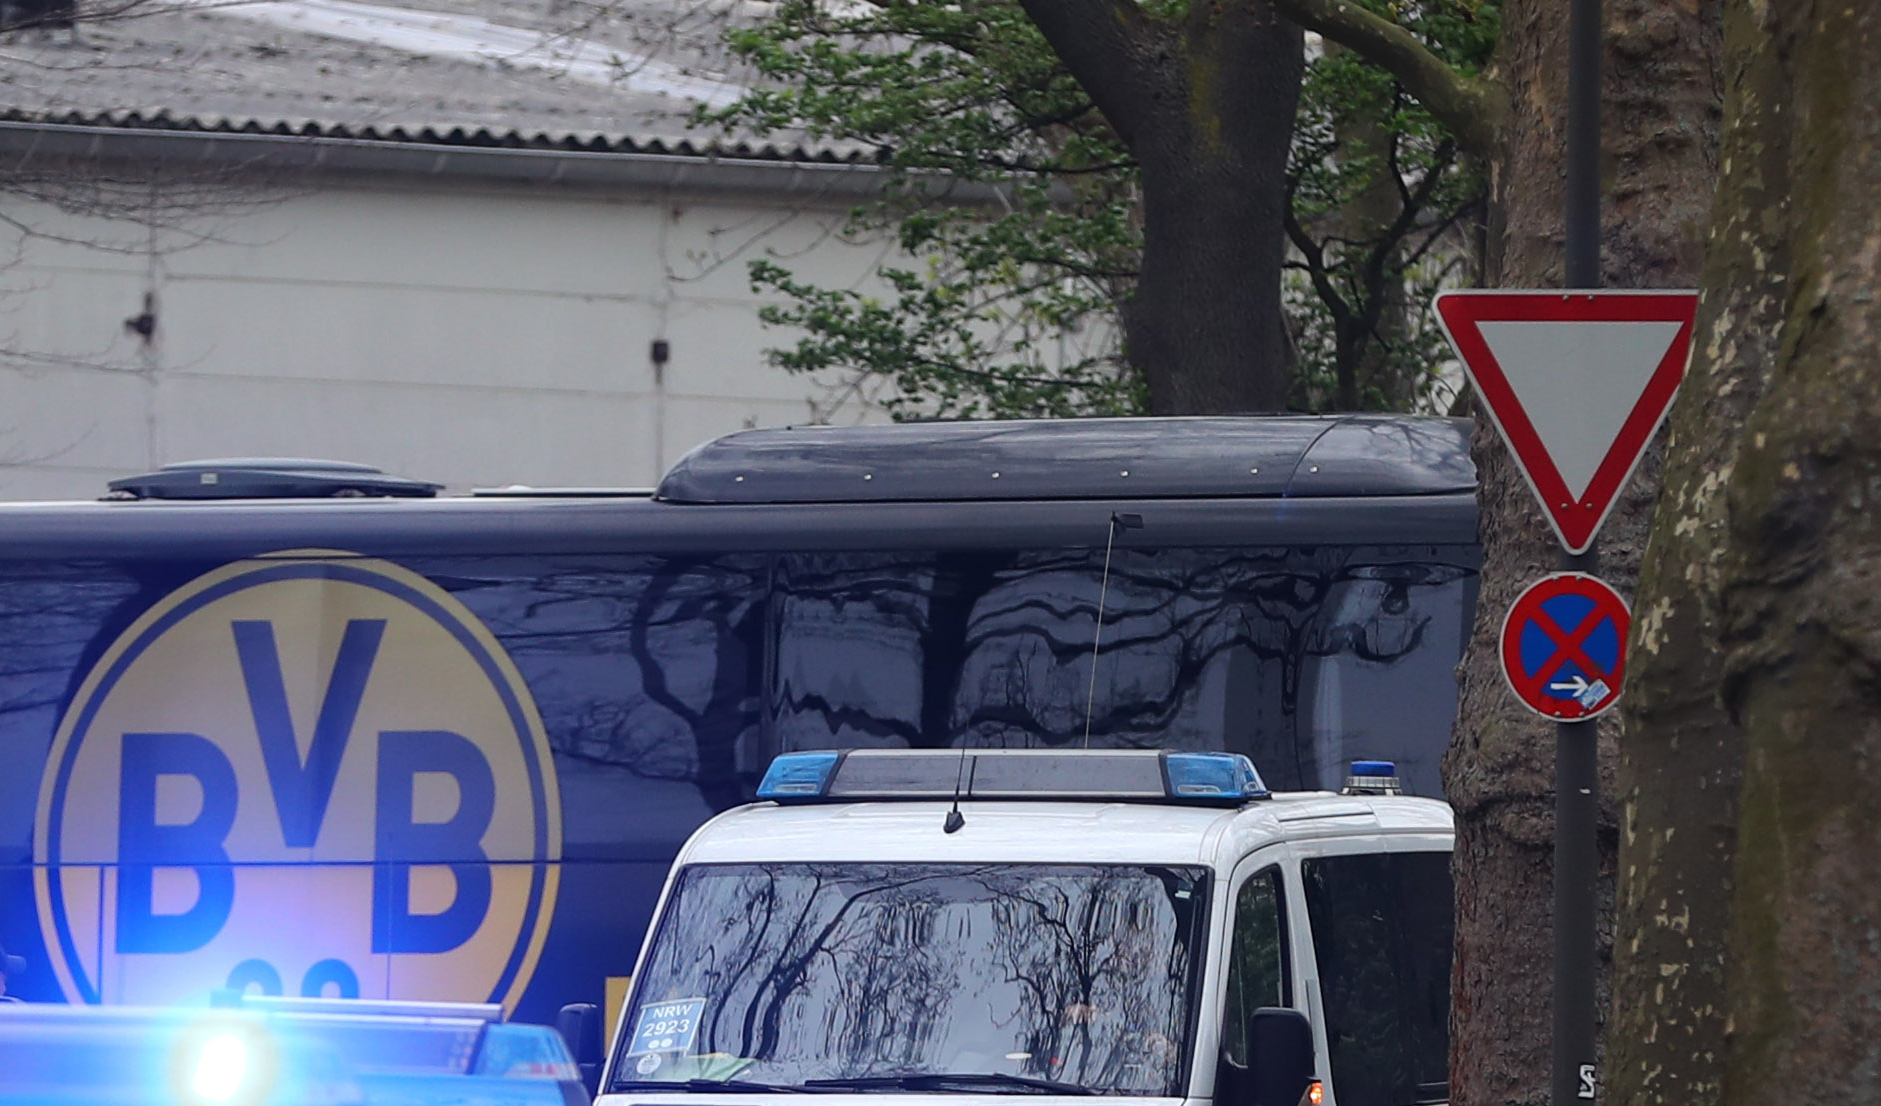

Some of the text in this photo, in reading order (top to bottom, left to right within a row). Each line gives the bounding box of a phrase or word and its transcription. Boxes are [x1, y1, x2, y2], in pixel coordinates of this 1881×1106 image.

[114, 618, 497, 956] BVB
[652, 1003, 694, 1019] NRW
[641, 1018, 691, 1038] 2923
